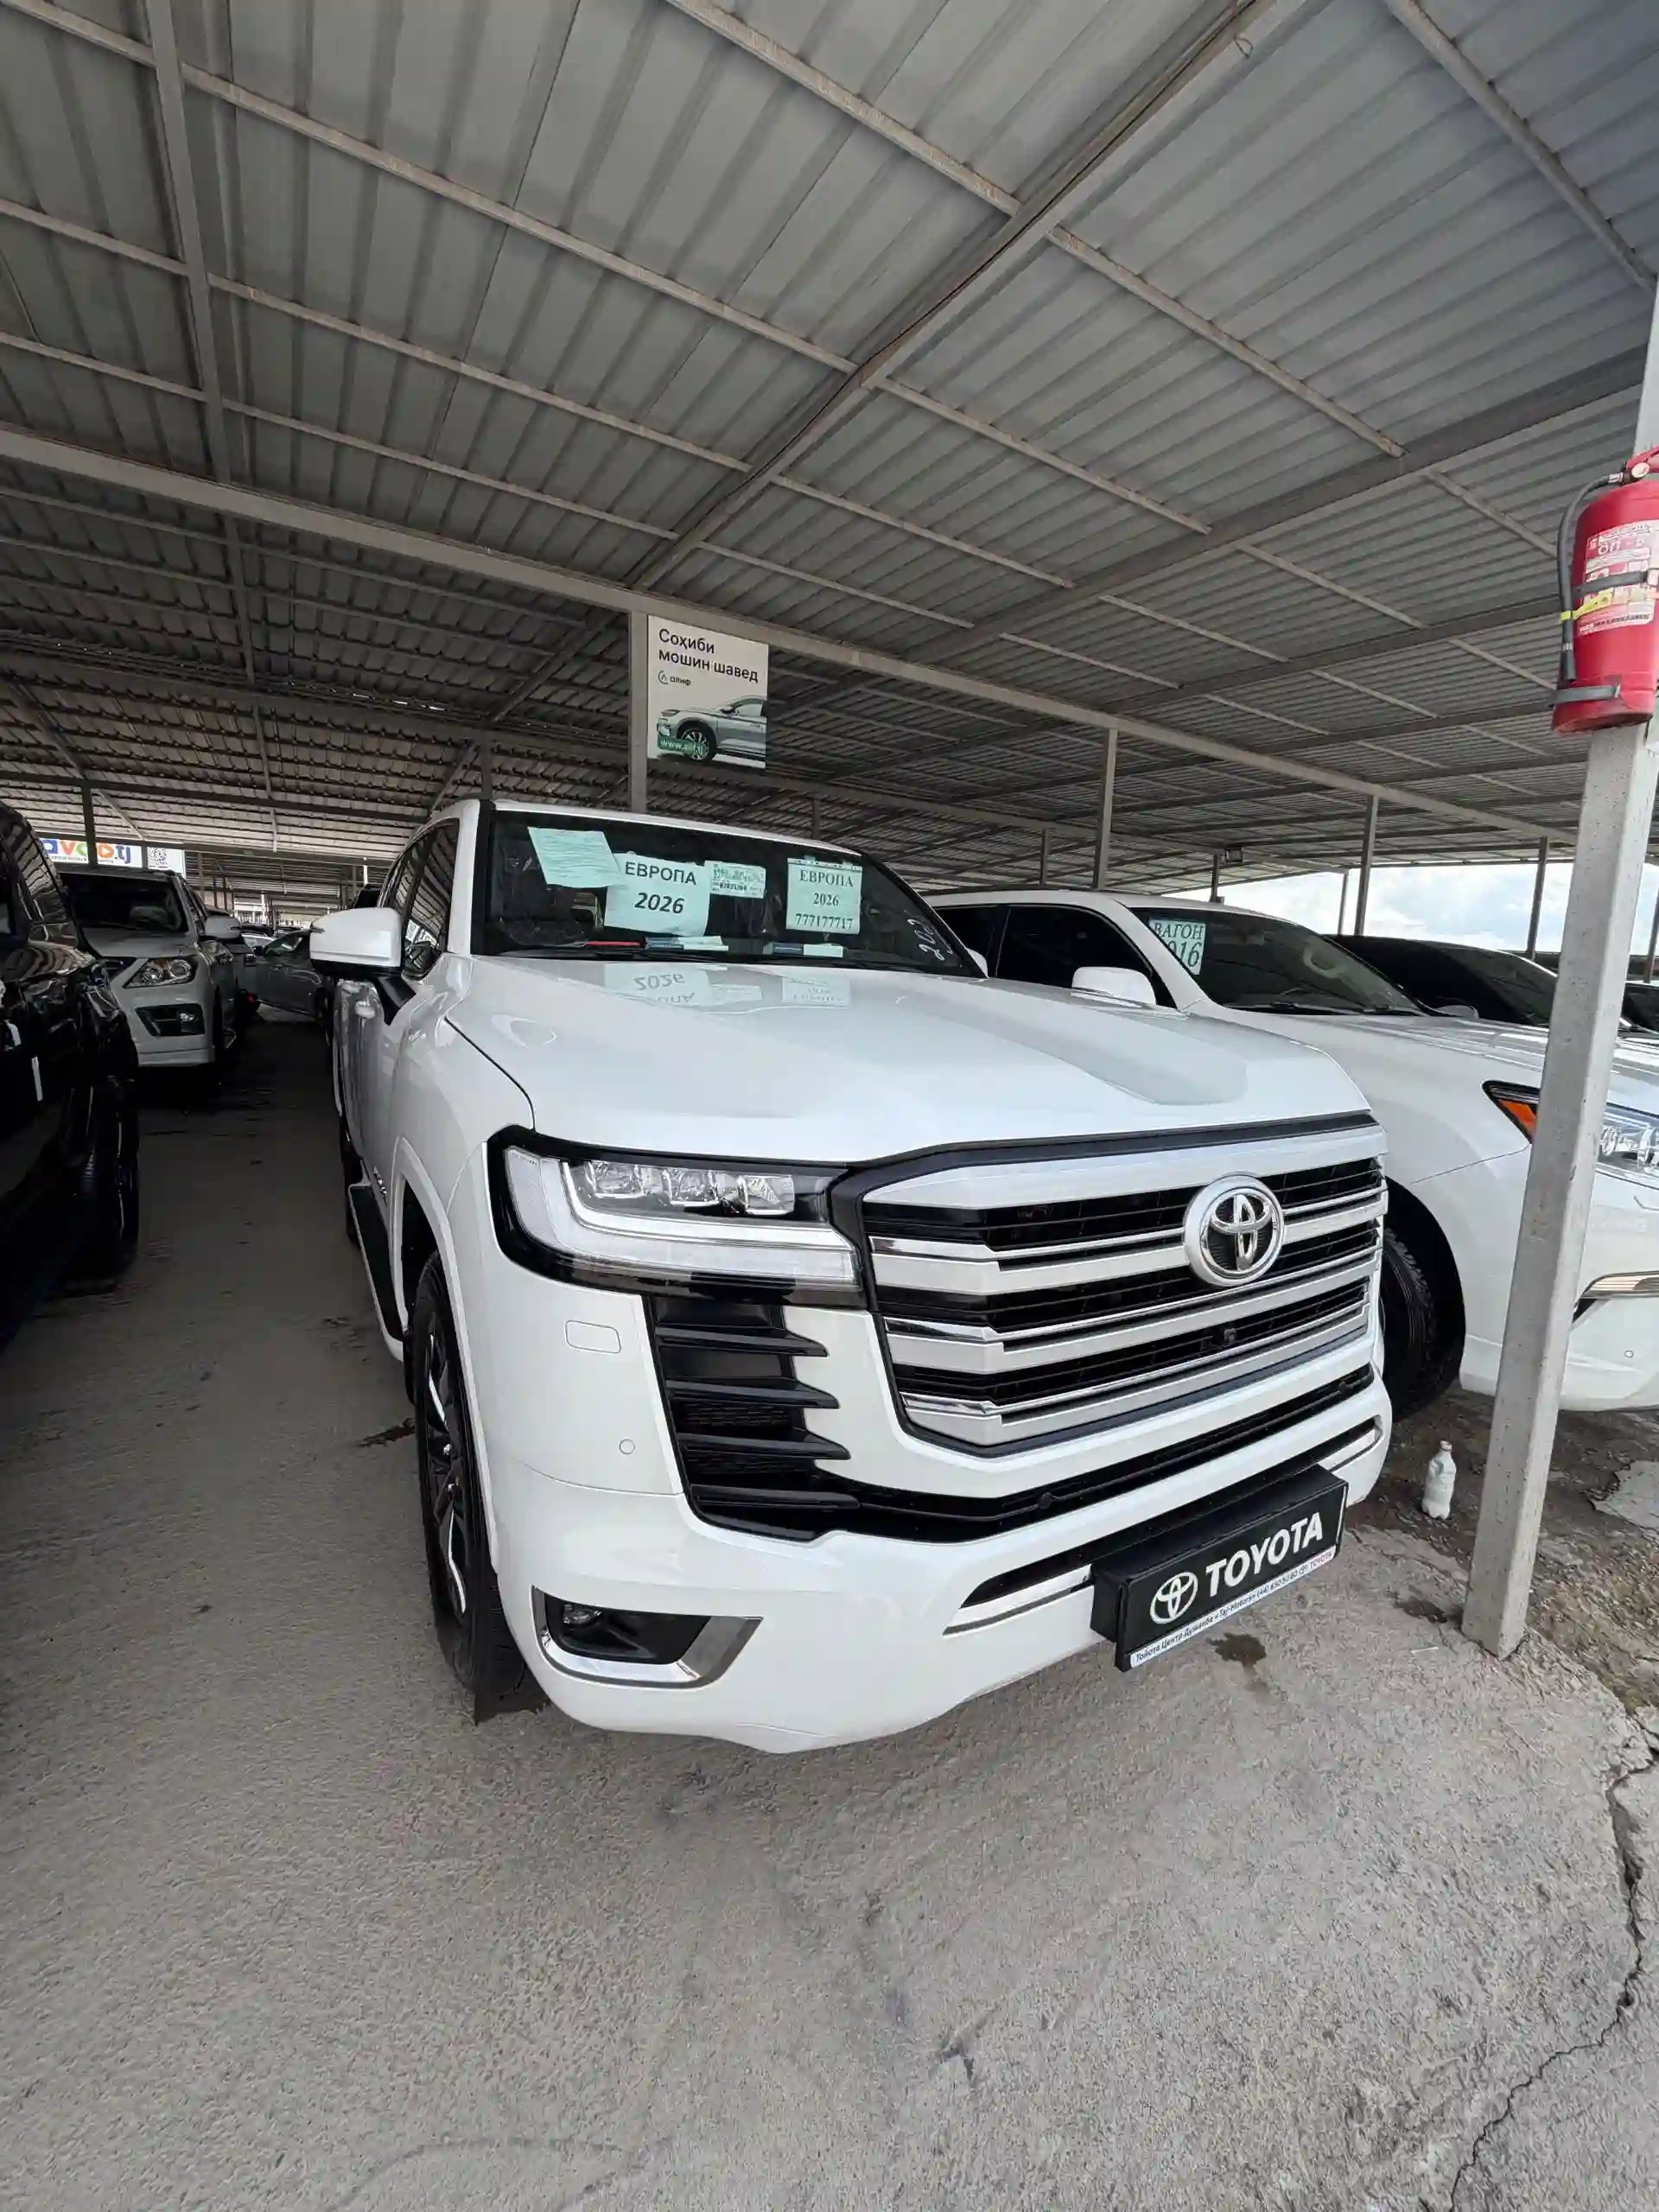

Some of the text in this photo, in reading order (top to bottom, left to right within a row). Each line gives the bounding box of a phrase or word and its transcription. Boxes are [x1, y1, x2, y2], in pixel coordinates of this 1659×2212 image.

[658, 628, 715, 654] Соҳиби
[658, 649, 759, 683] мошин шавед
[625, 861, 696, 886] ЕВРОПА
[799, 868, 854, 888] ЕВРОПА
[634, 892, 685, 914] 2026
[813, 892, 839, 906] 2026
[796, 912, 854, 930] 777177717
[1205, 1512, 1324, 1598] TOYOTA
